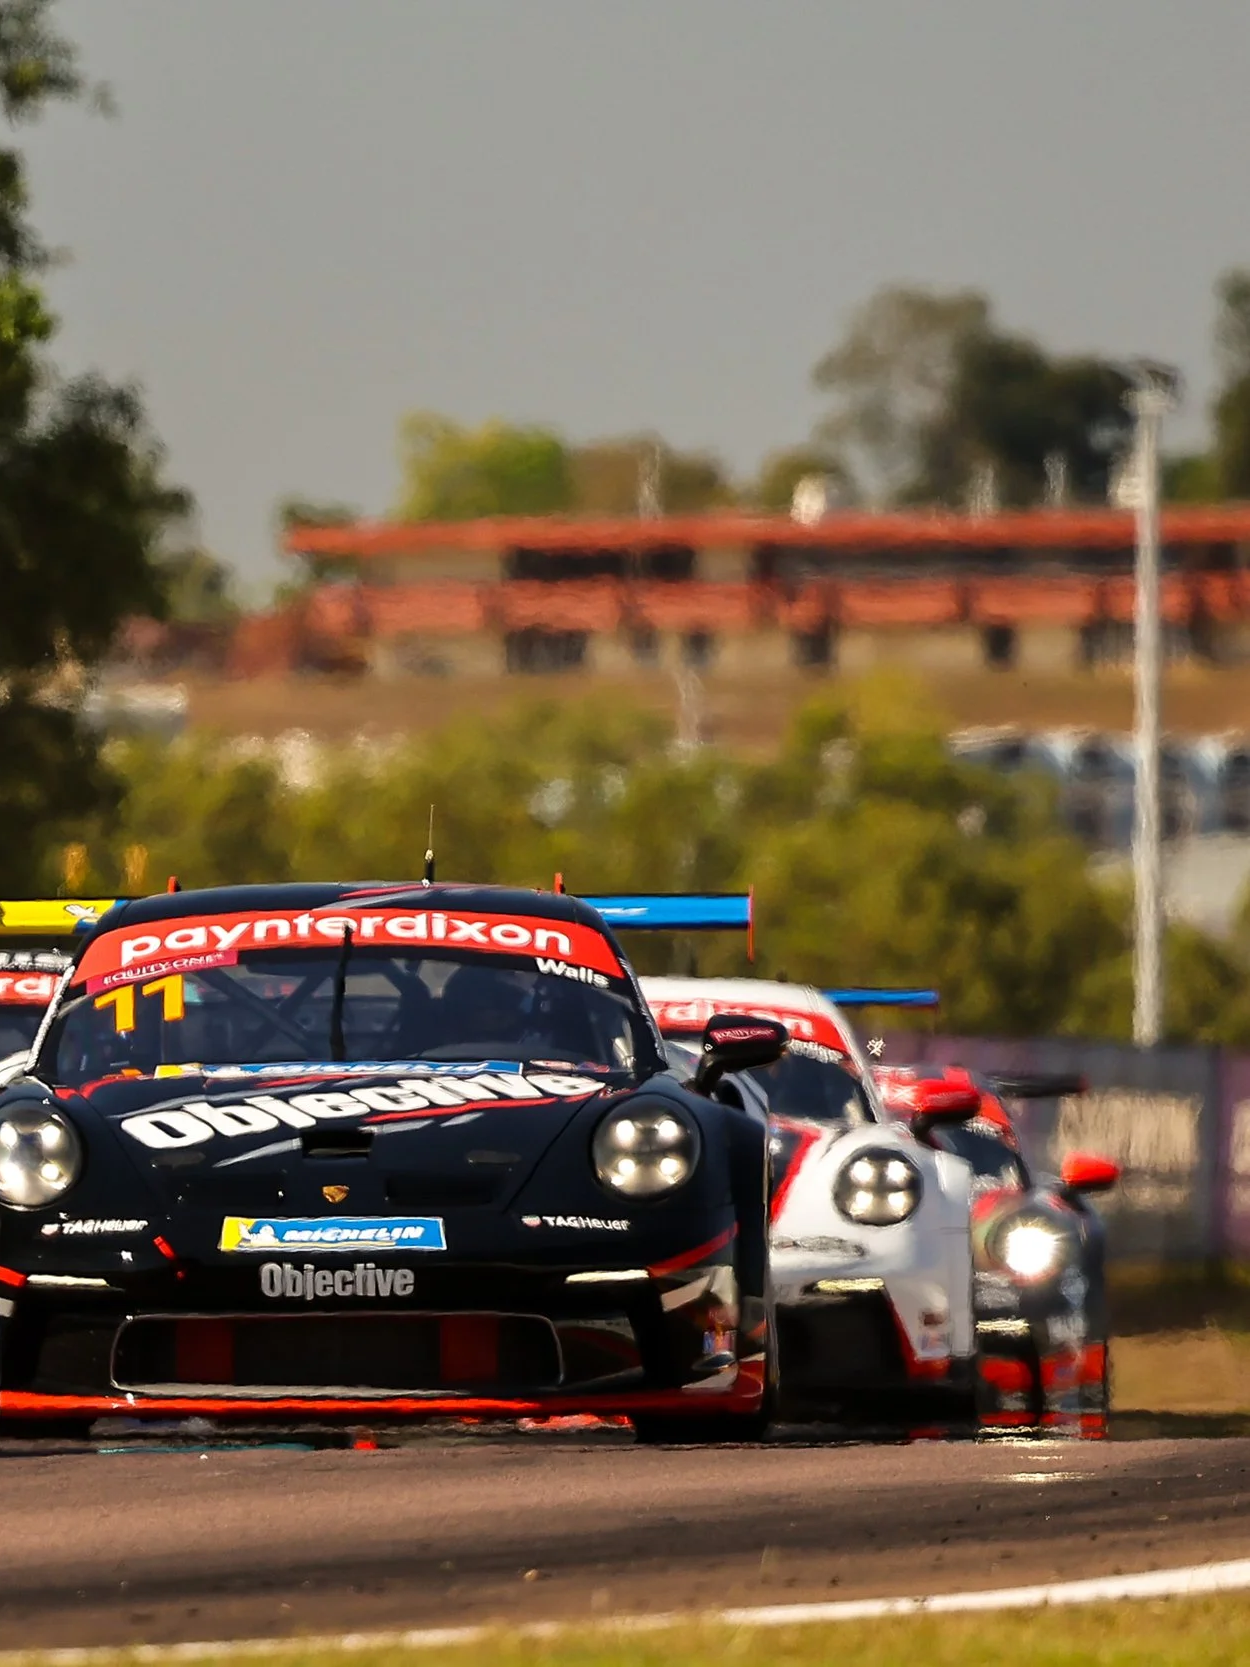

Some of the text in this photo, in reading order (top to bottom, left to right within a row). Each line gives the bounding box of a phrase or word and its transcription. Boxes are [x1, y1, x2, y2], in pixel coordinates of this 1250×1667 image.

[121, 912, 572, 966] paynterdixon
[535, 957, 610, 988] Walls
[94, 974, 185, 1034] 11
[120, 1073, 607, 1149] Objective
[282, 1226, 425, 1241] MICHELIN
[261, 1262, 415, 1300] Objective
